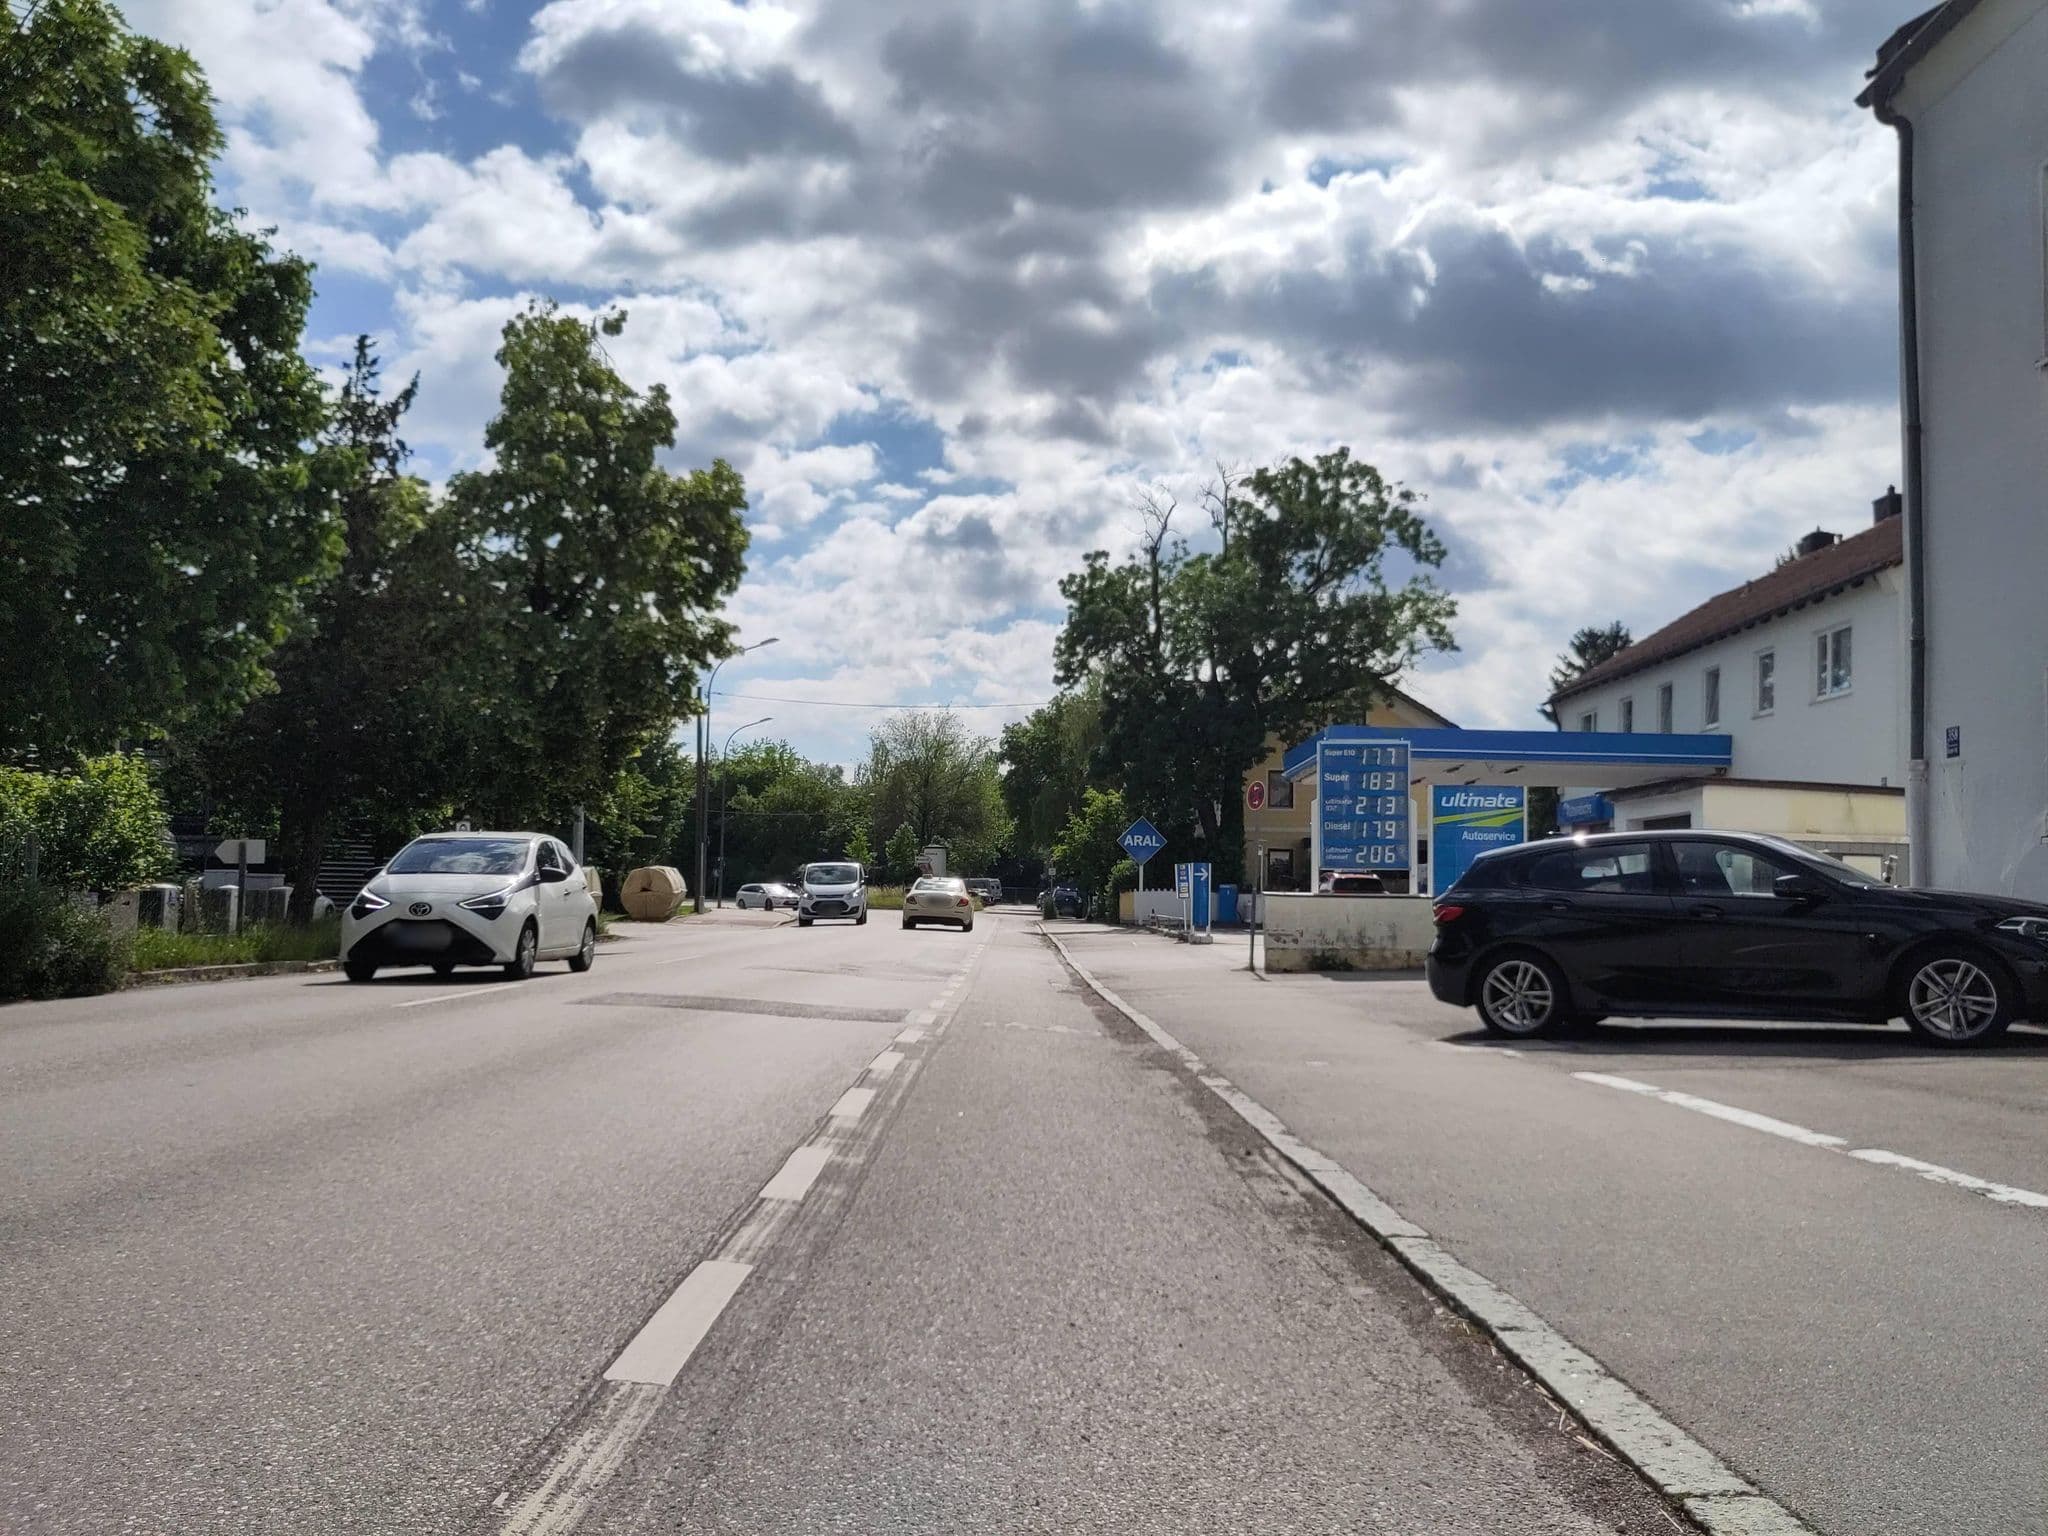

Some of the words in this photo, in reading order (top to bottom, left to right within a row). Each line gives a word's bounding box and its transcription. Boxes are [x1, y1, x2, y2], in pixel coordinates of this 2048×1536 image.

[1362, 748, 1395, 765] 177
[1324, 773, 1349, 782] Super
[1362, 772, 1395, 790] 183
[1355, 796, 1395, 815] 213
[1441, 792, 1517, 808] ultimate
[1324, 821, 1351, 830] Diesel
[1362, 820, 1396, 839] 179
[1462, 831, 1516, 841] Autoservice
[1124, 835, 1160, 847] ARAL
[1355, 845, 1395, 864] 206
